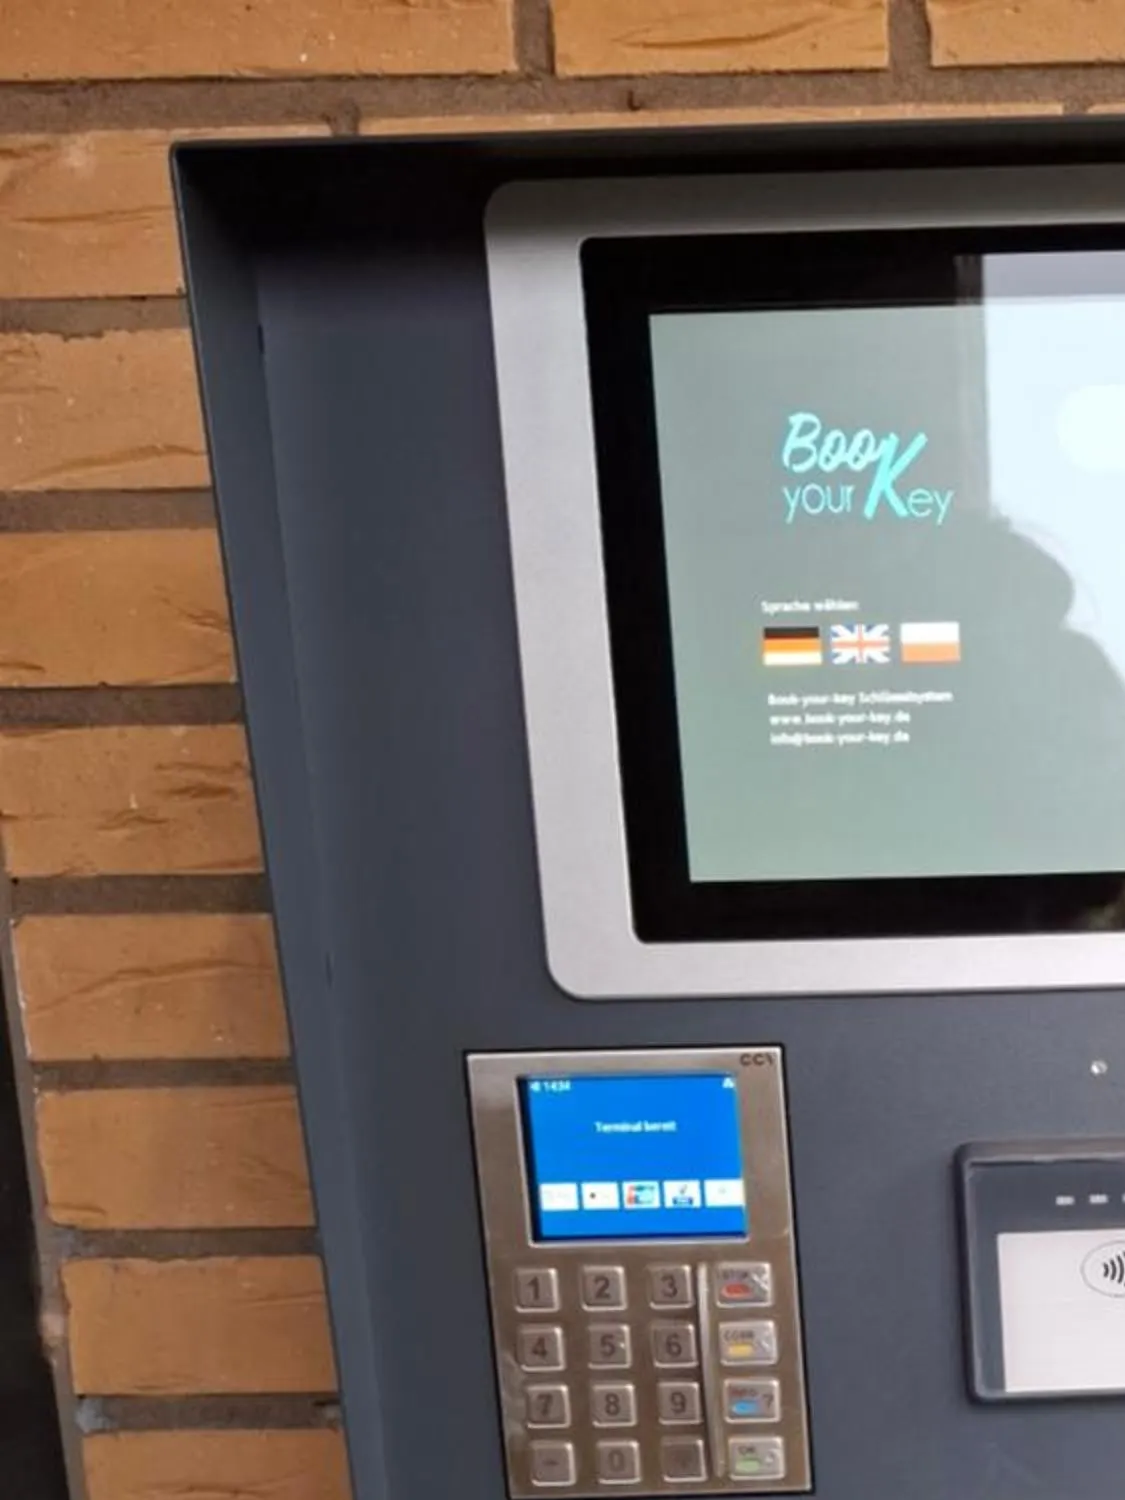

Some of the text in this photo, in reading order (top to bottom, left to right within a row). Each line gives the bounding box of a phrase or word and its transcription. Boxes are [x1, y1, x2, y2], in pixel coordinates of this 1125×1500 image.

[782, 483, 856, 524] your
[594, 1120, 642, 1133] Terminal
[527, 1274, 678, 1300] 1 2 3
[531, 1334, 682, 1357] 4 5 6
[537, 1392, 686, 1416] 7 8 9
[608, 1449, 624, 1472] 0
